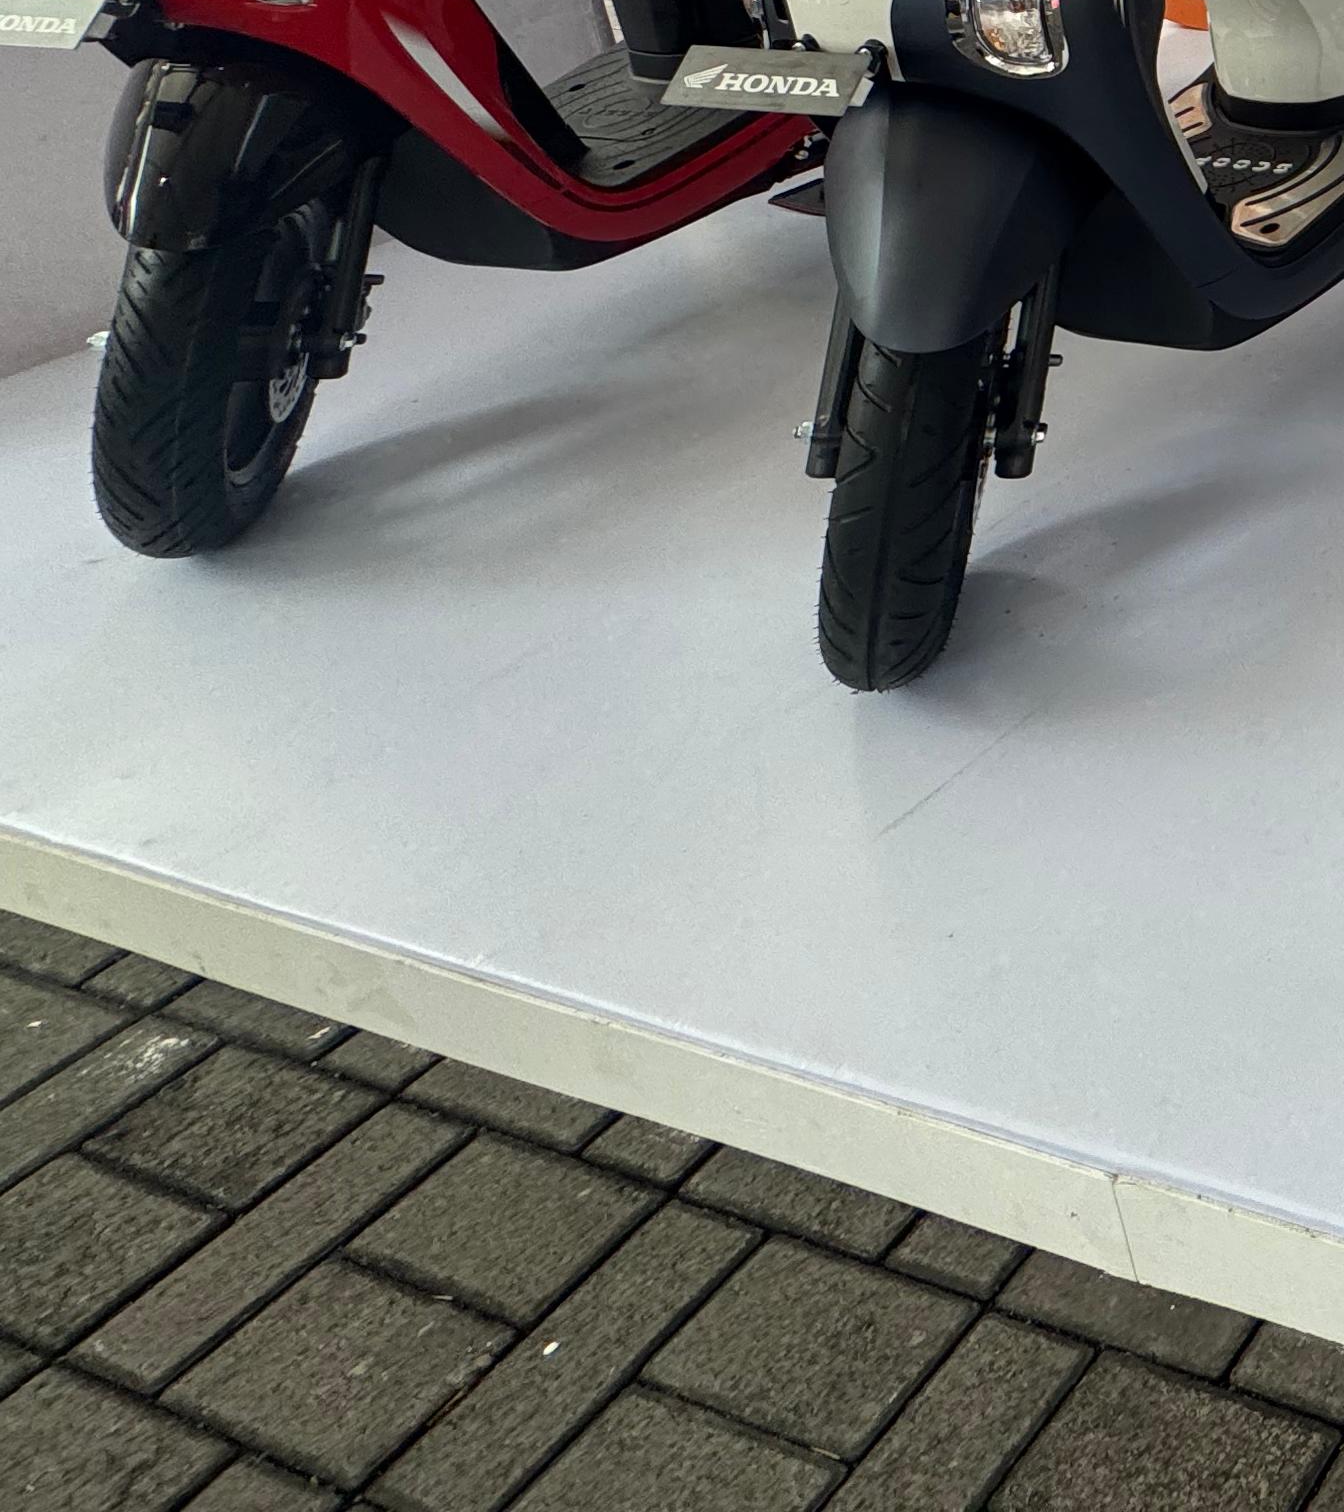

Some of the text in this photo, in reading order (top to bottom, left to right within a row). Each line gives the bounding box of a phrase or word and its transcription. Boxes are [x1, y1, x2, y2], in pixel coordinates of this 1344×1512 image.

[0, 14, 77, 35] ONDA
[715, 70, 841, 98] HONDA
[1195, 155, 1294, 175] SCOOP
